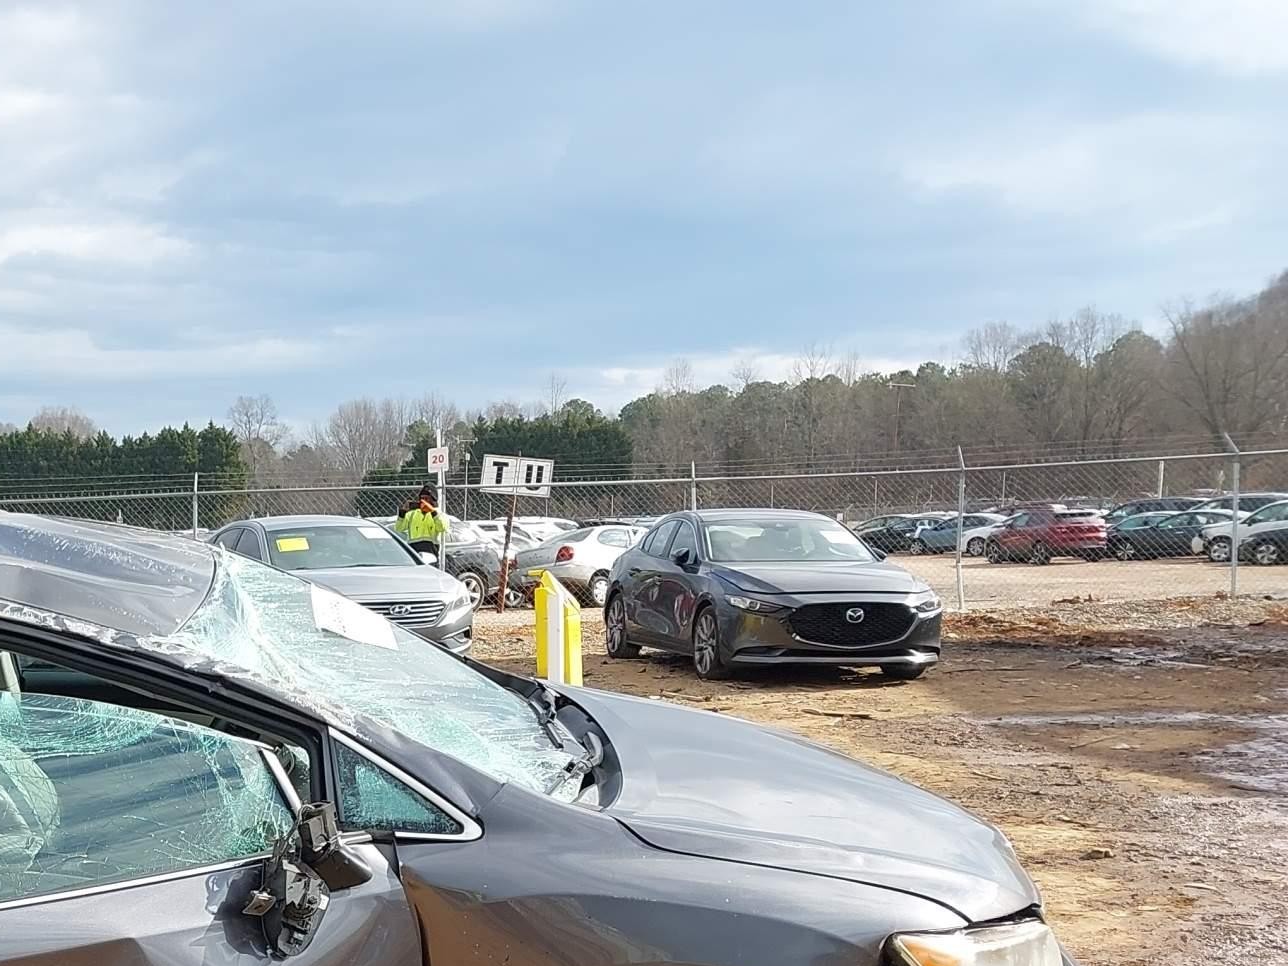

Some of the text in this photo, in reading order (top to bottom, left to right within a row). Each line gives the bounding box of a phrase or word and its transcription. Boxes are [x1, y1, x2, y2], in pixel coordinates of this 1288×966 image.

[432, 454, 445, 464] 20
[492, 461, 544, 491] T U
